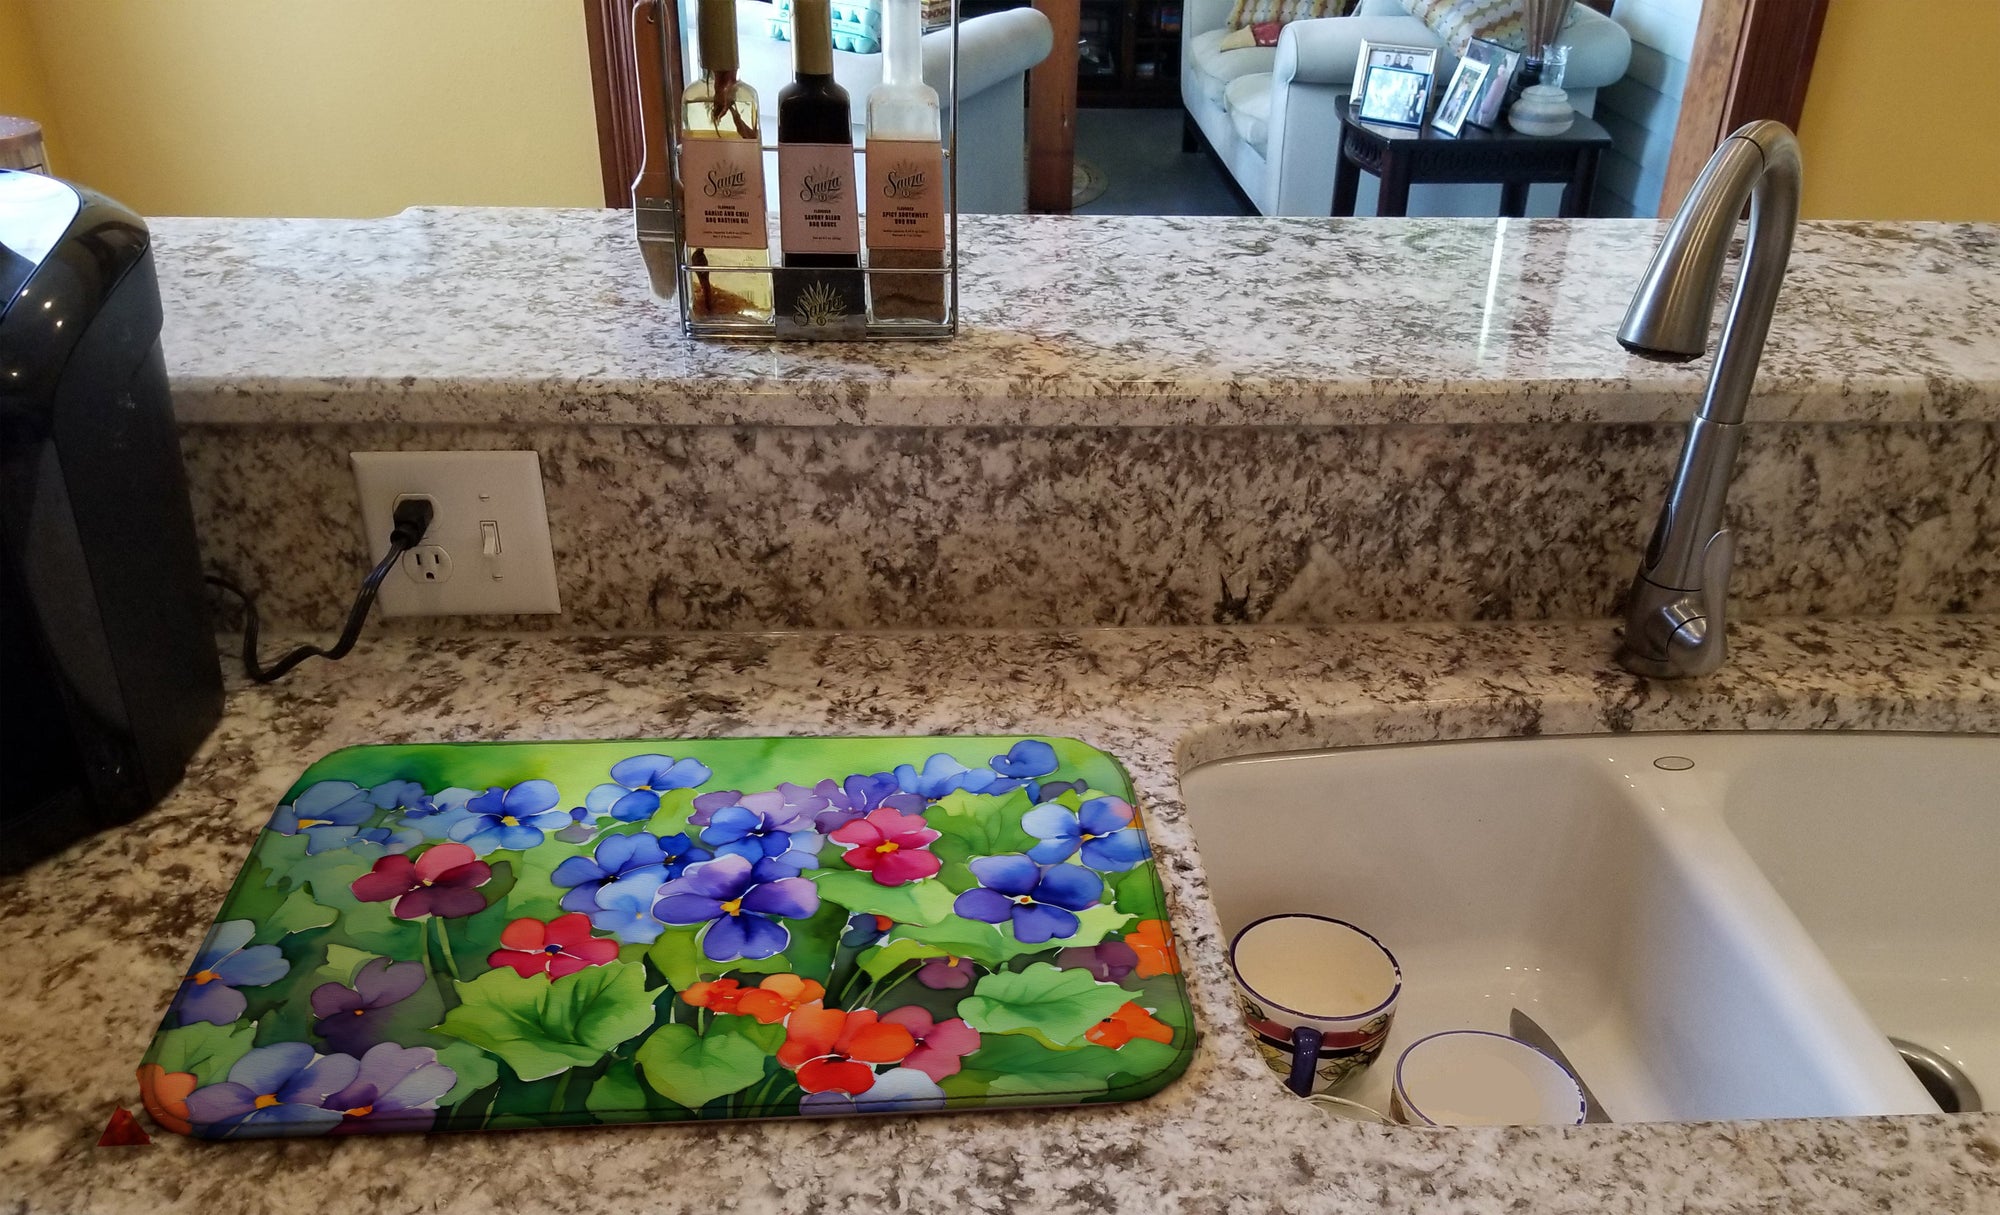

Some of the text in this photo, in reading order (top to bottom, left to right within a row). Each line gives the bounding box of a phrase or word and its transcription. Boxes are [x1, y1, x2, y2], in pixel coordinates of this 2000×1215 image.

[704, 170, 745, 197] Sauza
[800, 176, 841, 202] Sauza
[884, 171, 925, 198] Sauza
